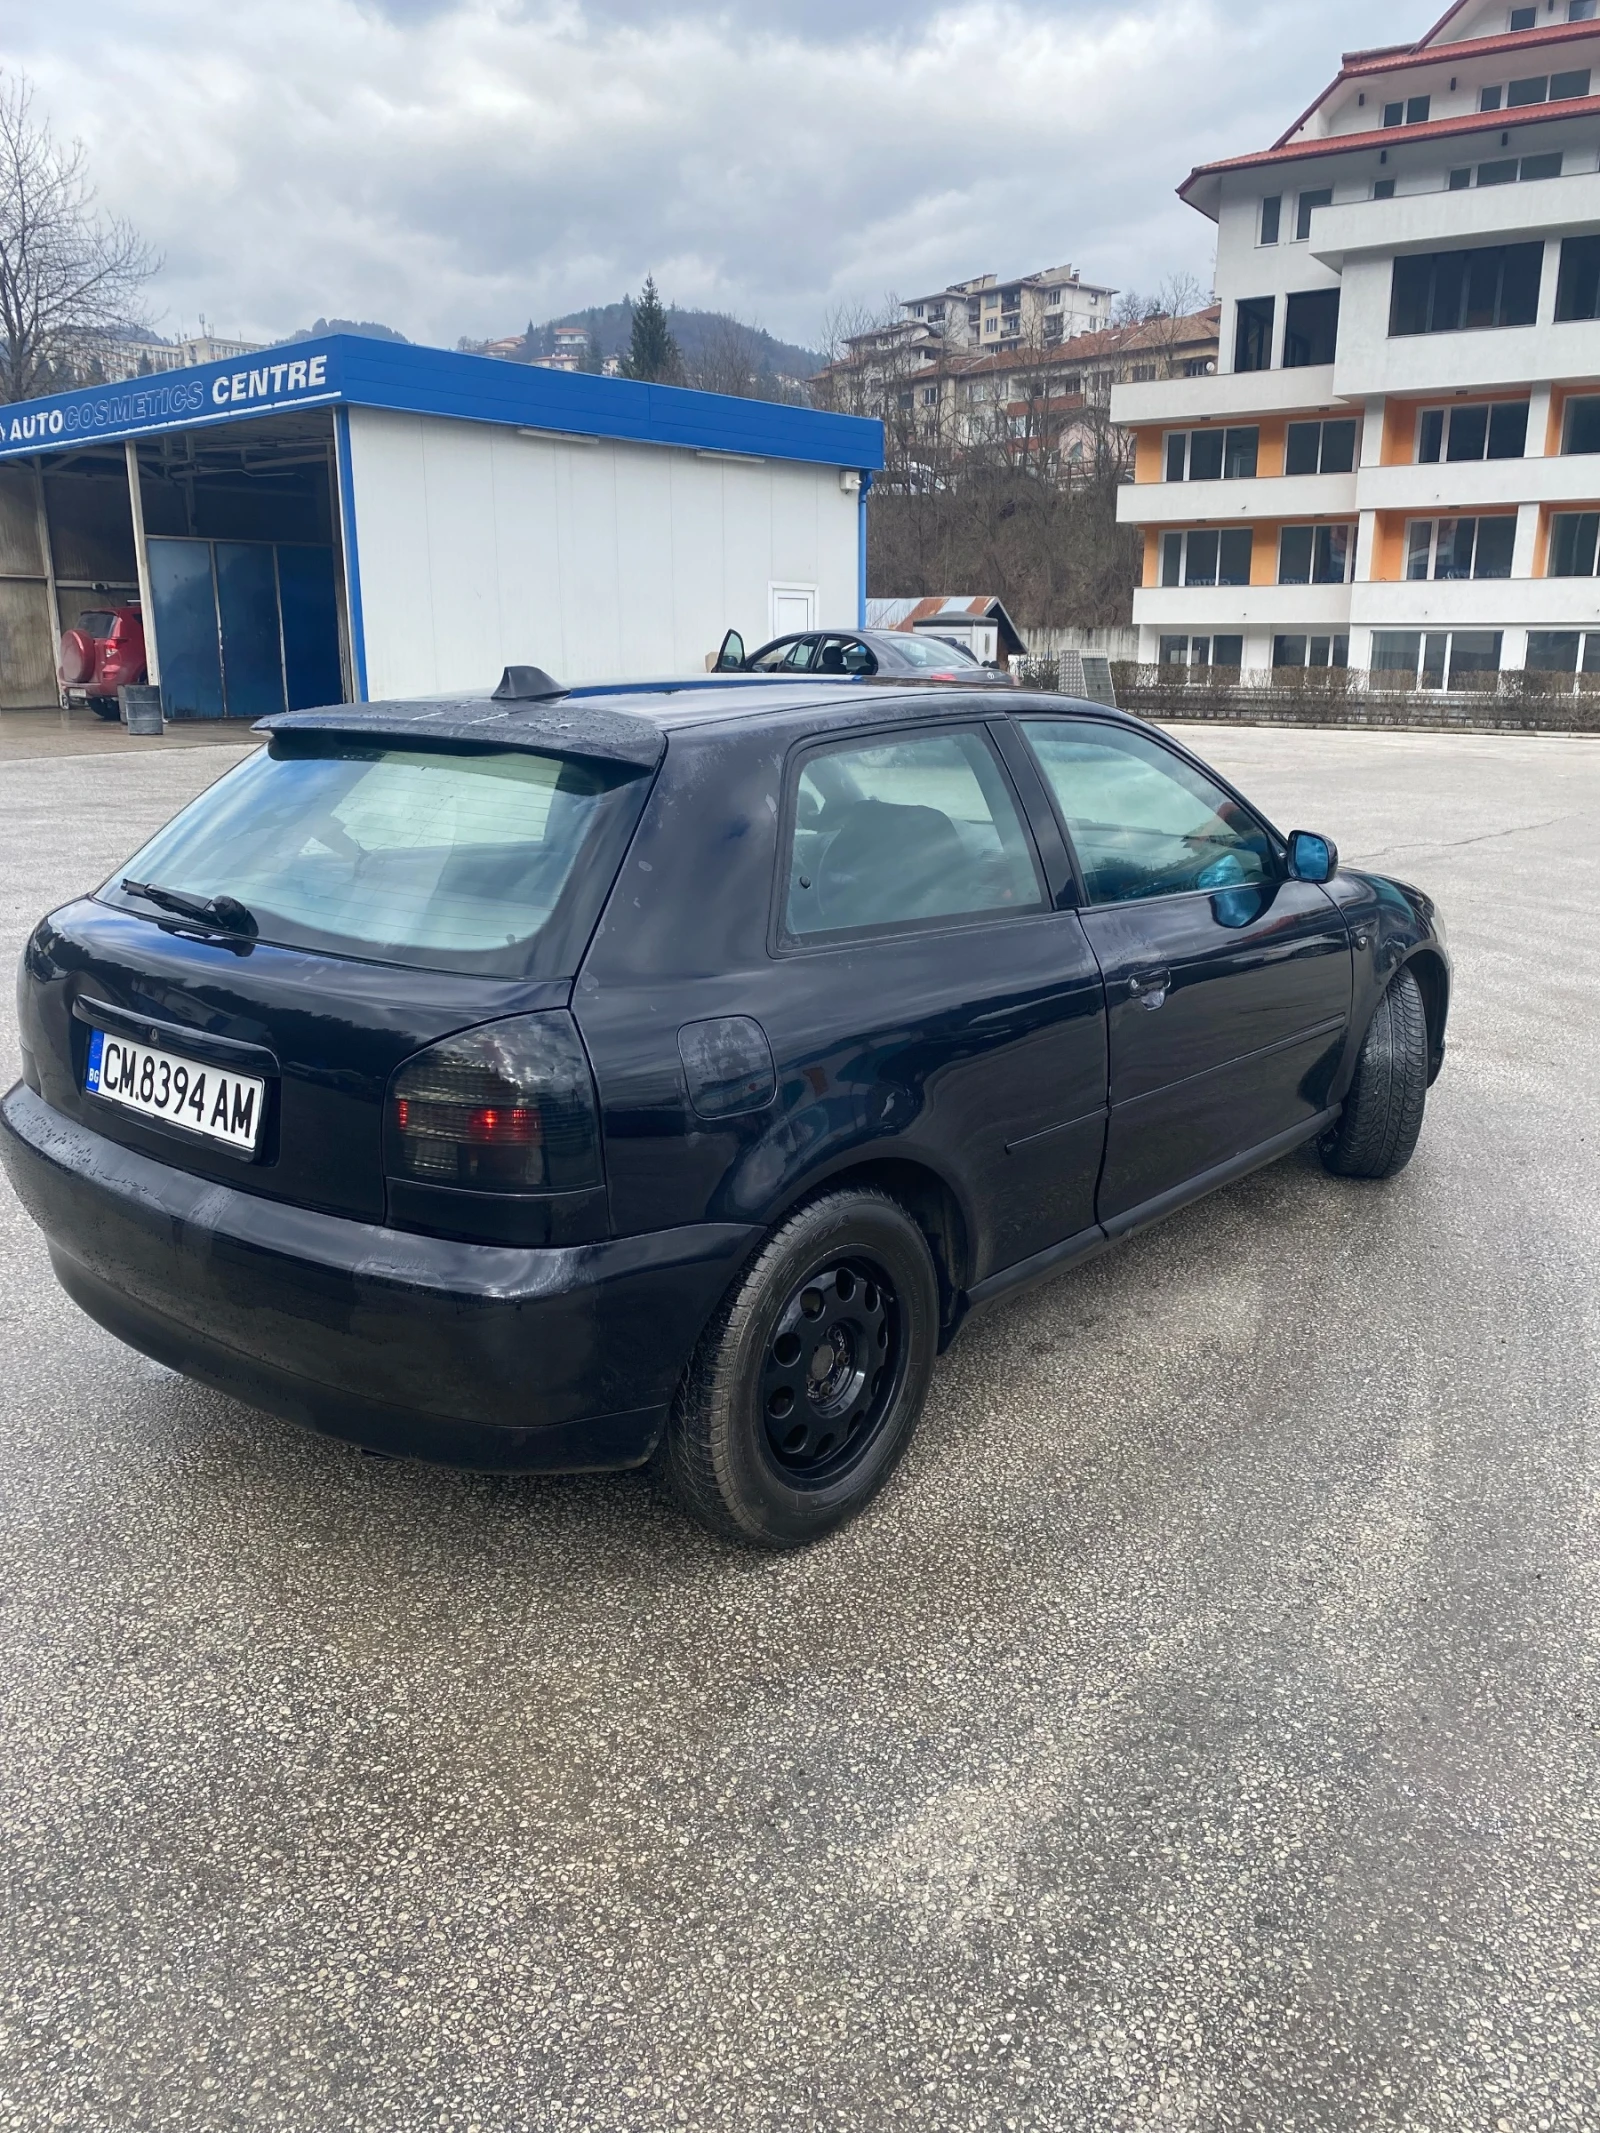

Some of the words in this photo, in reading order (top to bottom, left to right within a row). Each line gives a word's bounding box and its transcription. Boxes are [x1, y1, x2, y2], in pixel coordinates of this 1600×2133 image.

[211, 355, 327, 405] CENTRE
[88, 1068, 100, 1083] BG
[210, 1078, 255, 1138] AM
